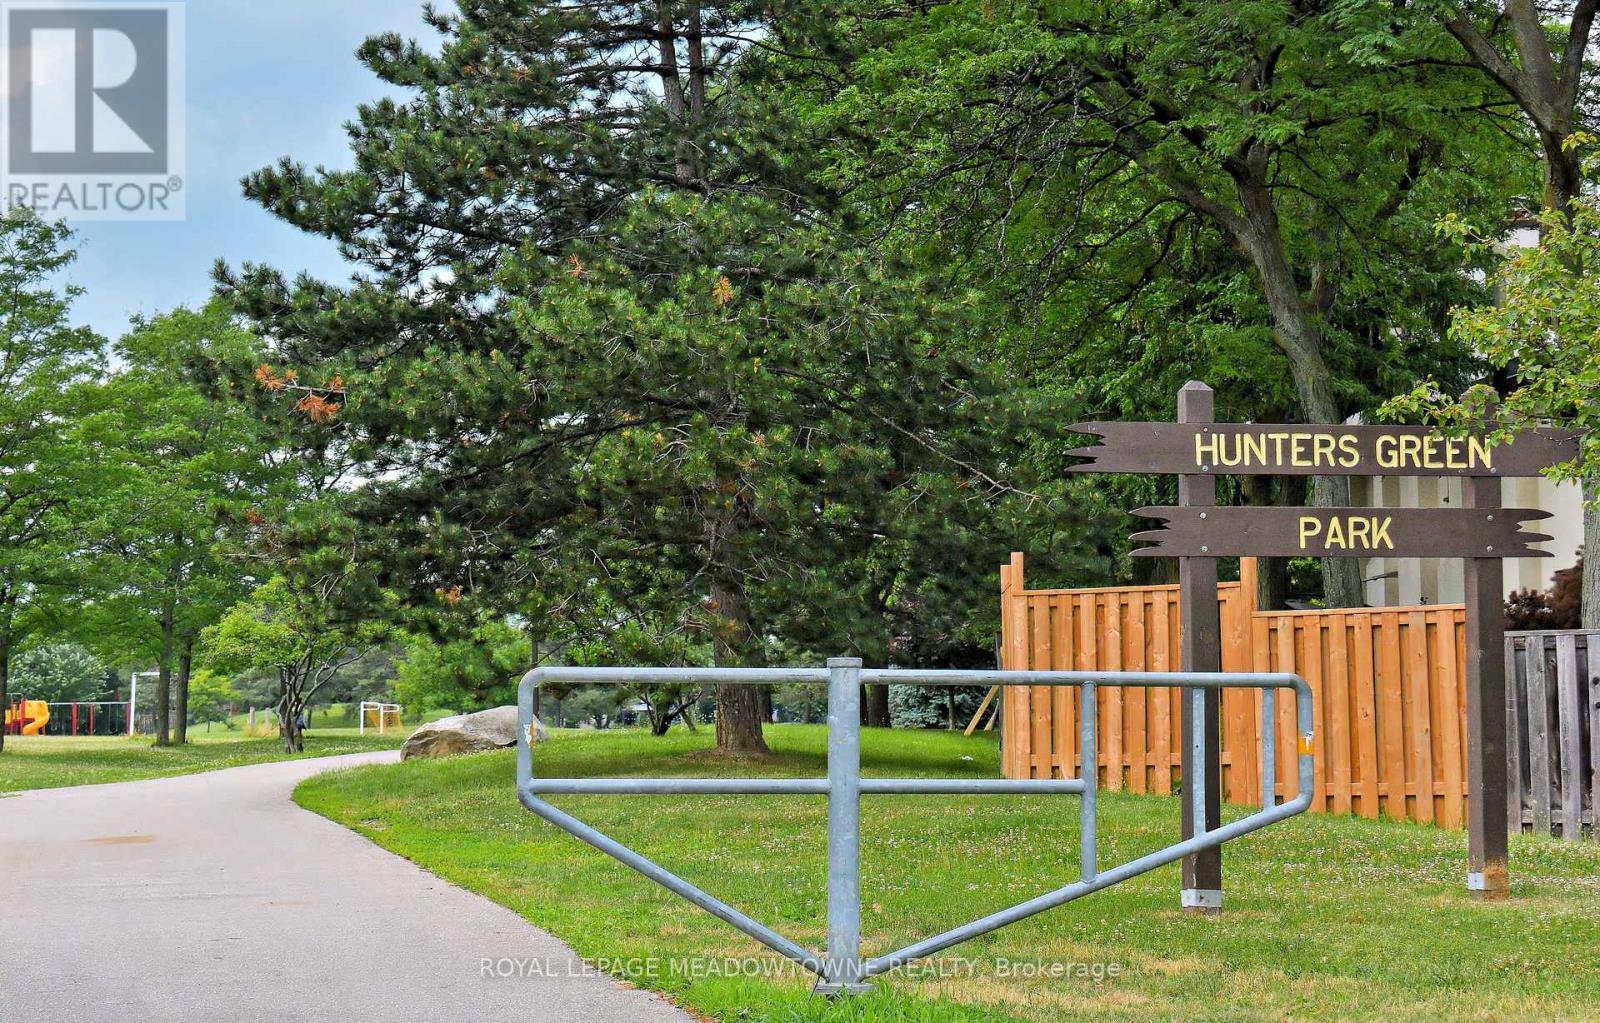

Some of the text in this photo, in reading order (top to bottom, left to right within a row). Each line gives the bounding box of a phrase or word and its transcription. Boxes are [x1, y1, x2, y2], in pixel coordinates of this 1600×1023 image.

[1195, 433, 1493, 469] HUNTERS GREEN
[1299, 517, 1395, 550] PARK
